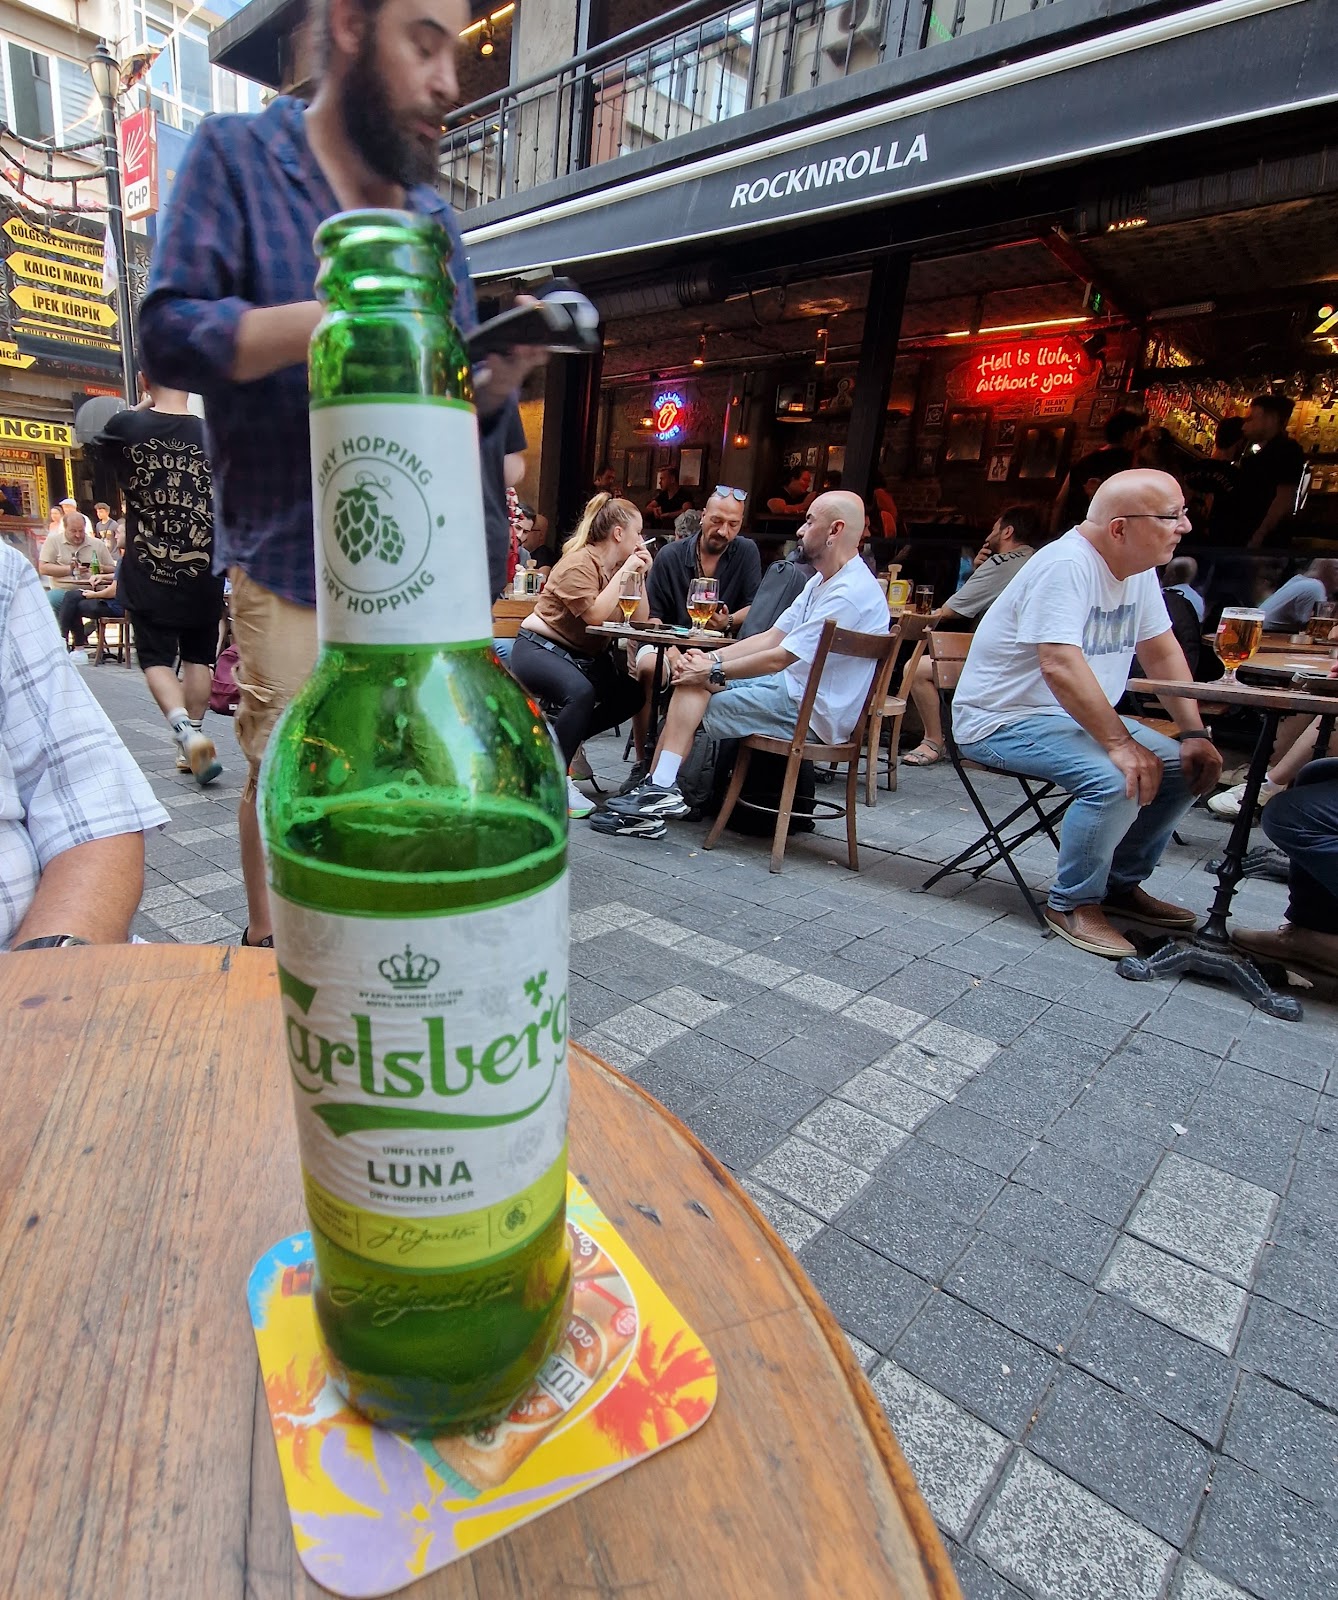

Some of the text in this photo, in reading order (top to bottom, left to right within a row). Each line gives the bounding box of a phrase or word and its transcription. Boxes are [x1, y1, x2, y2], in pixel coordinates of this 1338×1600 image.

[730, 133, 928, 209] ROCKNROLLA
[127, 185, 148, 210] CHP
[23, 259, 61, 281] KALICI
[32, 292, 101, 322] İPEK KİRPİK
[977, 351, 1013, 376] Hell
[976, 372, 1074, 394] without you
[654, 391, 683, 410] ROLLING
[1044, 398, 1069, 406] HEAVY
[144, 452, 203, 477] ROCK
[317, 435, 433, 488] DRY HOPPING
[166, 470, 183, 488] N
[138, 487, 208, 515] ROLLA
[346, 569, 436, 615] HOPPING
[382, 1146, 455, 1157] UNFILTERED
[367, 1159, 473, 1189] LUNA
[440, 1190, 475, 1203] LAGER
